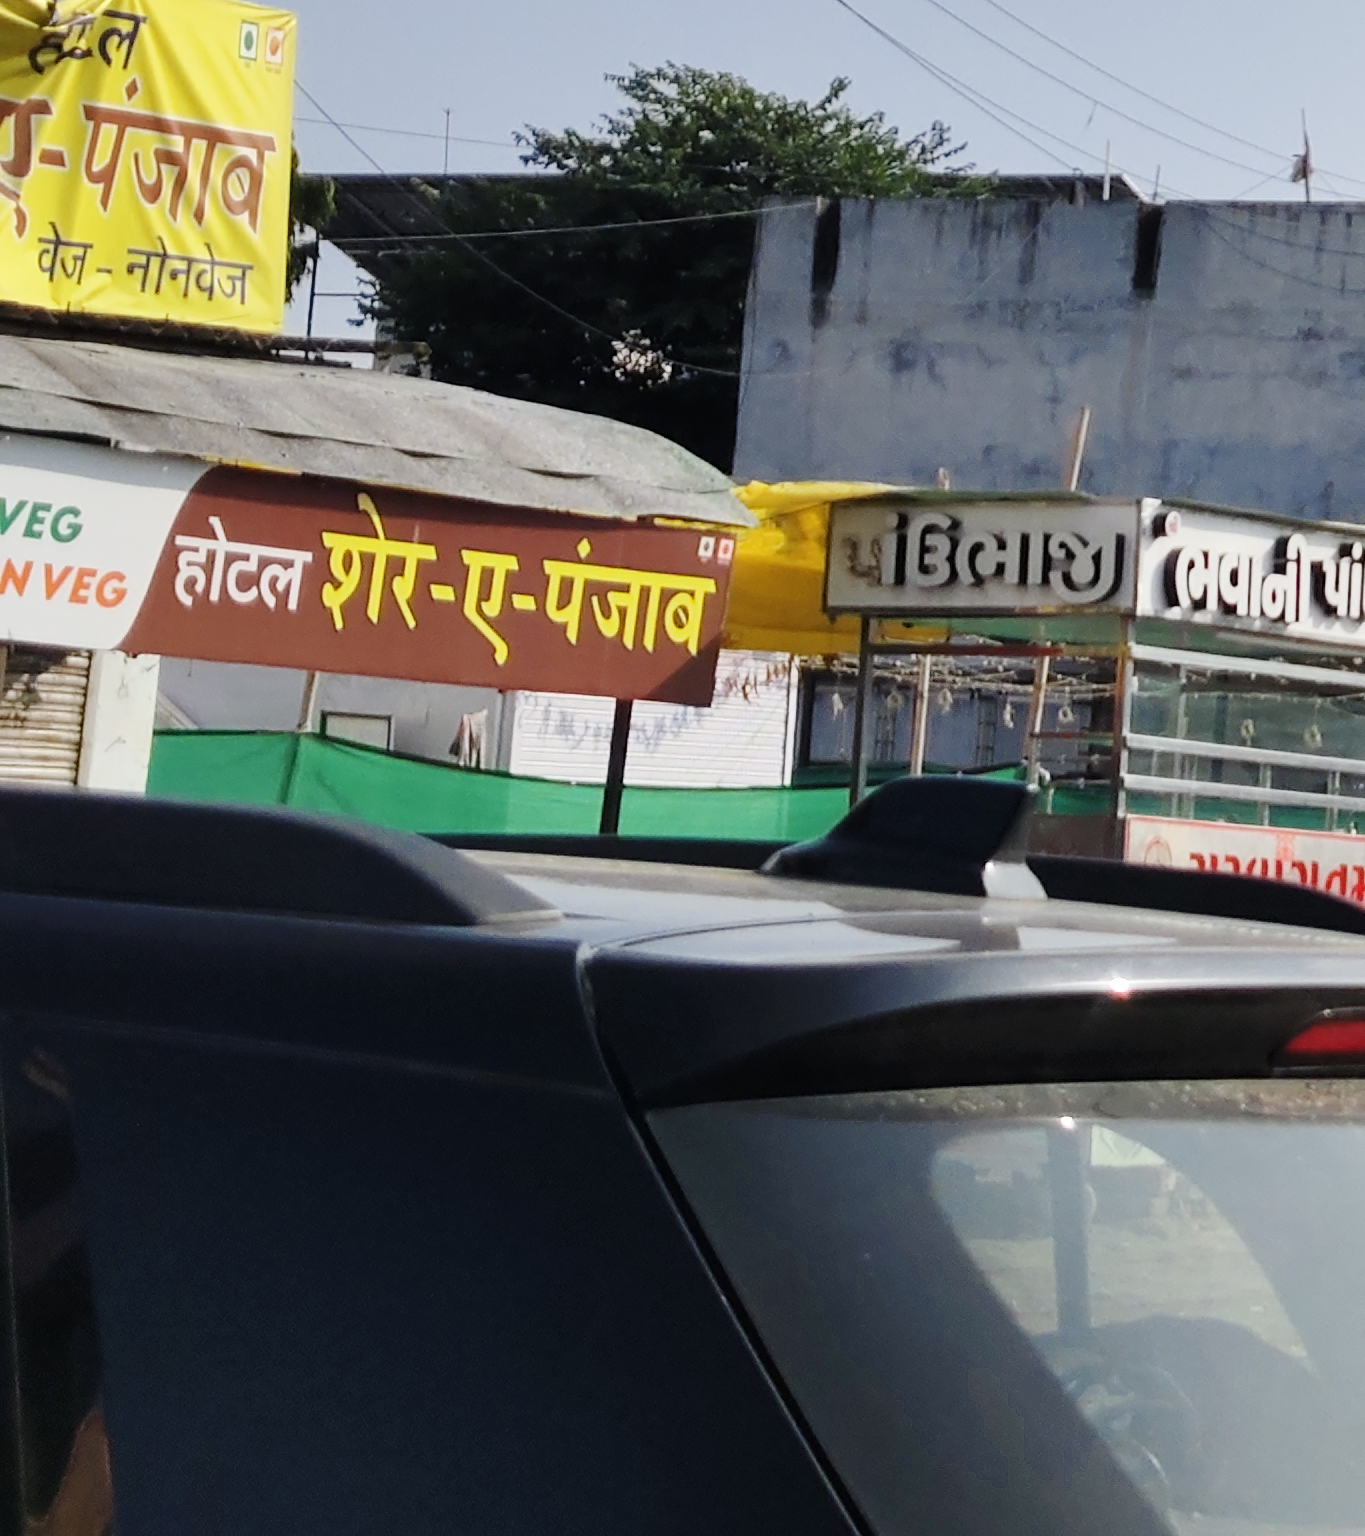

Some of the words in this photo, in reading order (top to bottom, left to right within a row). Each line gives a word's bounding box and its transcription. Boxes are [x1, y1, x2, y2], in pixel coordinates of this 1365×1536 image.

[37, 221, 94, 285] वेज
[0, 496, 84, 544] VEG
[43, 562, 129, 609] VEG
[175, 515, 313, 614] होटल
[1172, 532, 1308, 624] ભવાની
